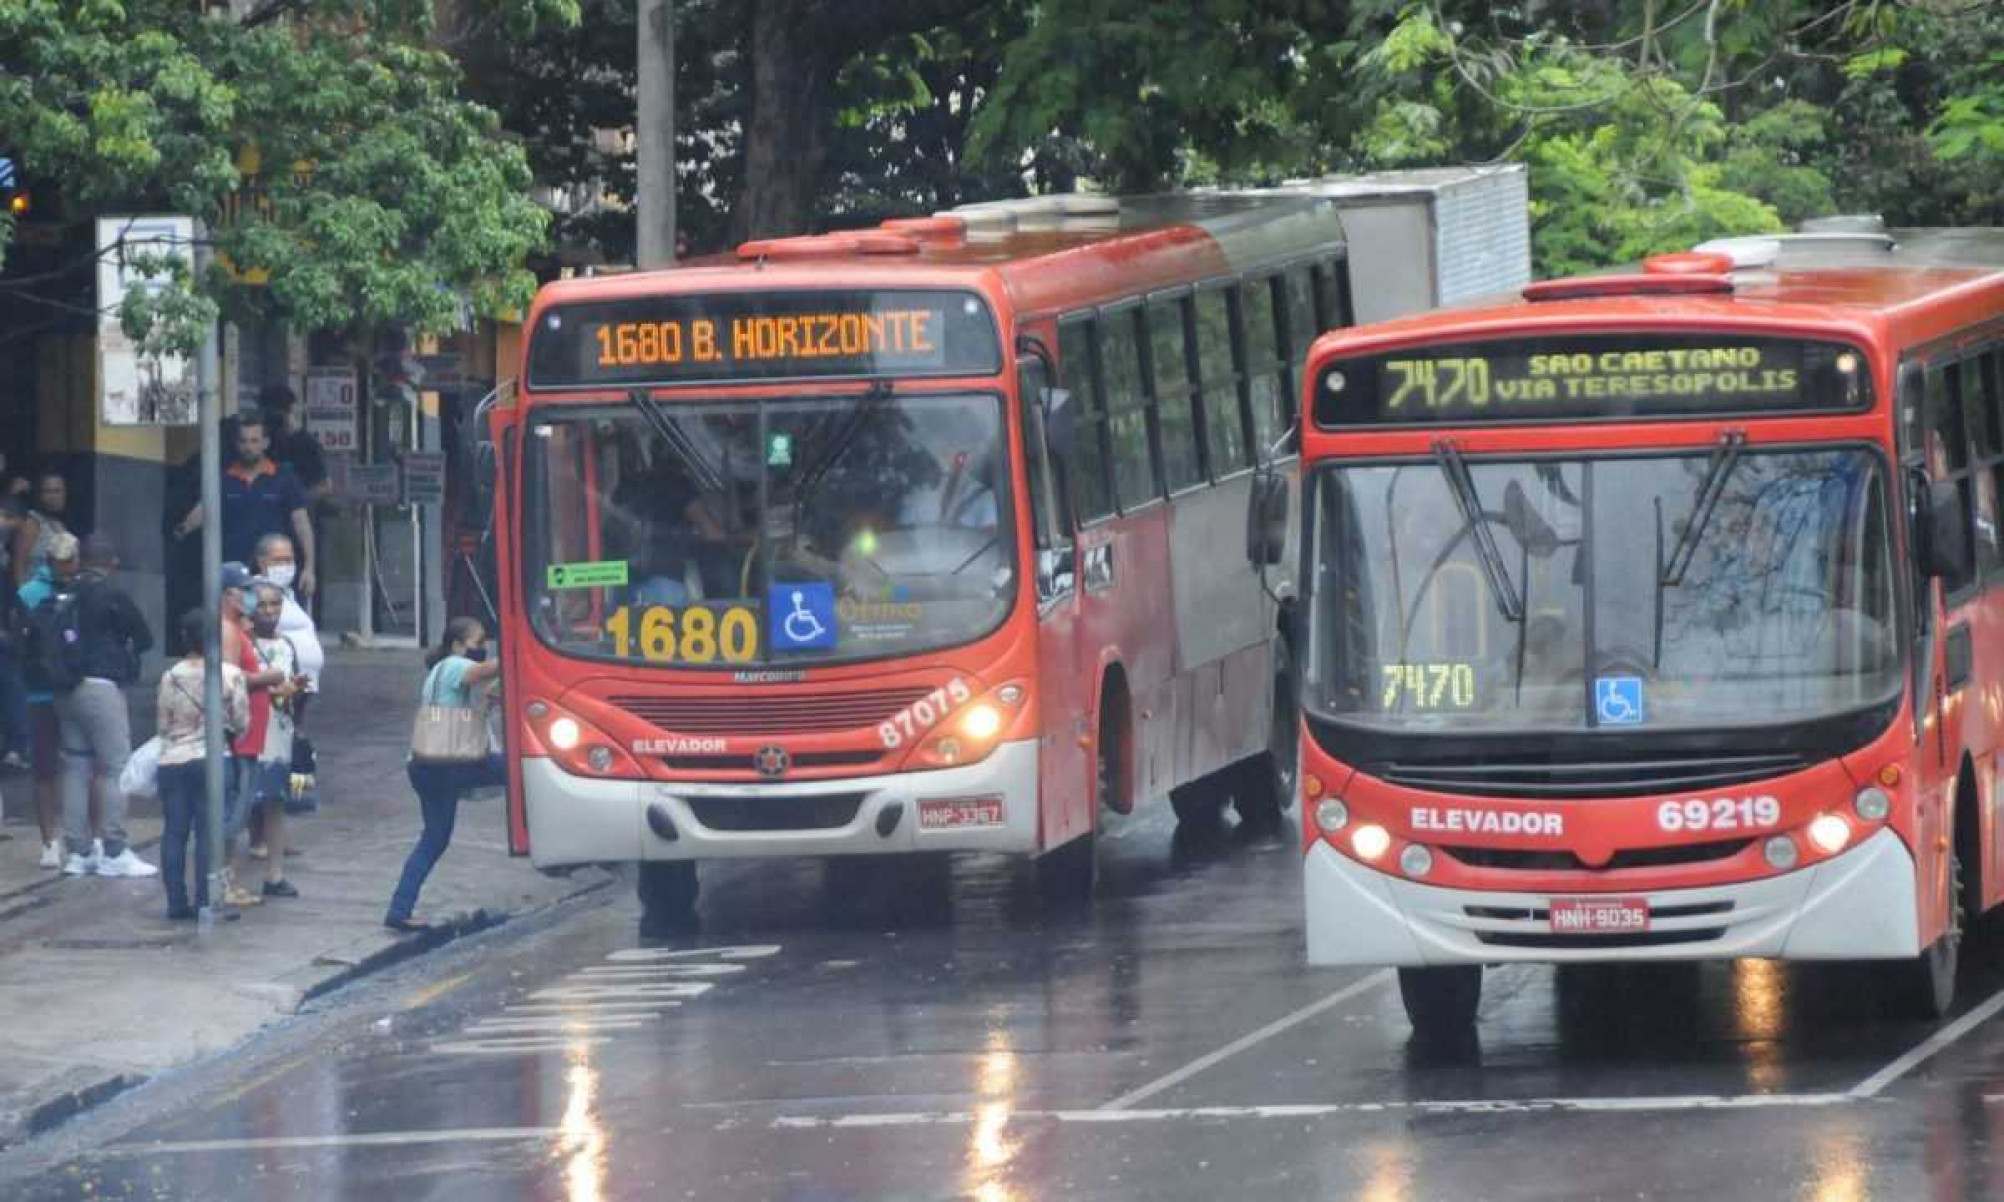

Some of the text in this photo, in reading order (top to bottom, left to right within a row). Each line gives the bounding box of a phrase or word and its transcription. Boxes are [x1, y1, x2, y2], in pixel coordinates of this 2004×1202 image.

[597, 310, 932, 365] 1680 B. HORIZONTE
[1528, 347, 1762, 375] SAO CAETANO
[1386, 357, 1490, 408] 7470
[1495, 370, 1797, 400] VIA TERESOPOLIS
[606, 605, 758, 664] 1680
[1383, 663, 1474, 708] 7470
[879, 677, 970, 748] 87075
[632, 738, 727, 754] ELEVADOR
[1411, 806, 1564, 836] ELEVADOR
[1657, 795, 1781, 832] 69219
